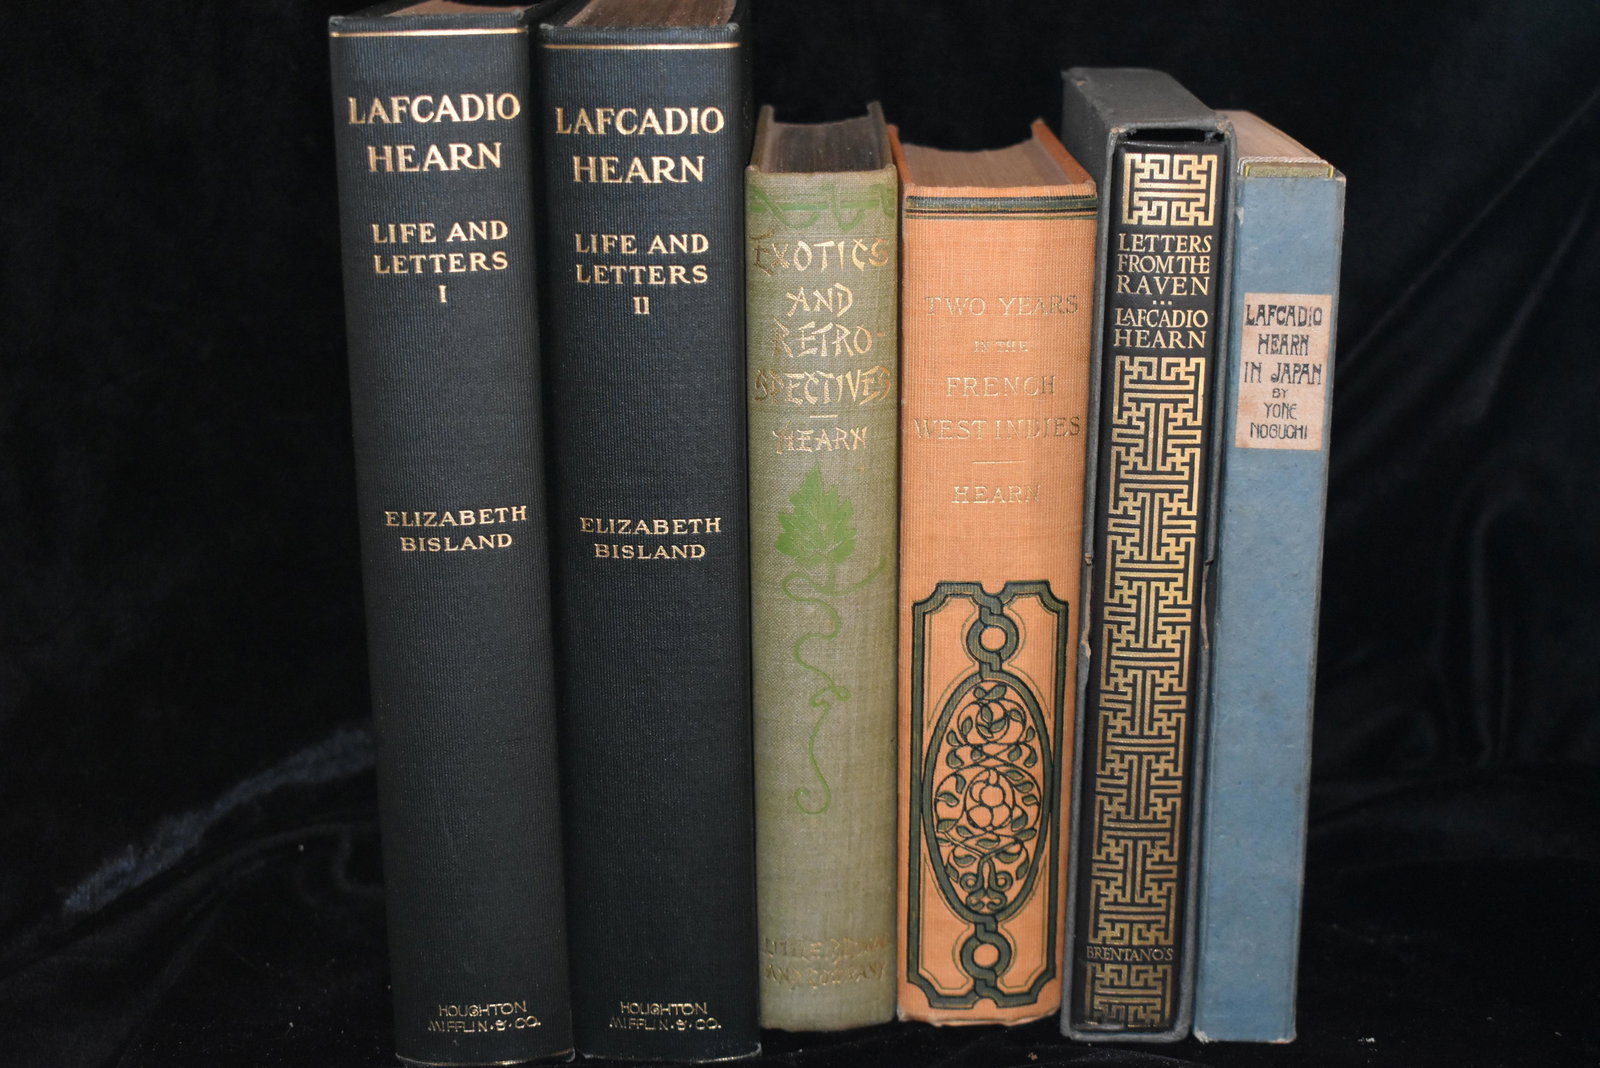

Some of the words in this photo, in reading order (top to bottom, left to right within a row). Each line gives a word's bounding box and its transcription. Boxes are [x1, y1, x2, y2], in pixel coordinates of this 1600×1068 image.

[348, 92, 521, 125] LAFCADIO
[555, 106, 725, 136] LAFCADIO
[367, 142, 503, 173] HEARN
[572, 155, 705, 184] HEARN
[372, 222, 437, 244] LIFE
[446, 220, 509, 242] AND
[574, 233, 637, 255] LIFE
[647, 233, 709, 255] AND
[749, 229, 889, 277] EXOTICS
[1118, 233, 1213, 253] LETTERS
[373, 251, 509, 275] LETTERS
[1117, 254, 1175, 274] FROM
[1176, 255, 1211, 274] THE
[575, 264, 709, 285] LETTERS
[1115, 274, 1211, 296] RAVEN
[438, 285, 448, 303] I
[786, 282, 854, 318] AND
[633, 296, 650, 315] II
[925, 296, 987, 316] TWO
[998, 295, 1079, 316] YEARS
[1244, 304, 1323, 327] LAFCADIO
[1114, 307, 1209, 328] LAFCADIO
[974, 340, 991, 353] IN
[995, 340, 1029, 353] THE
[1113, 328, 1207, 349] HEARN
[1257, 333, 1310, 356] HEARN
[1244, 361, 1262, 384] IN
[1270, 362, 1322, 385] JAPAN
[753, 365, 891, 407] SPECTIVES
[946, 375, 1056, 397] FRENCH
[1272, 387, 1288, 399] BY
[1263, 402, 1298, 420] YONE
[913, 417, 987, 440] WEST
[995, 416, 1081, 440] INDIES
[1250, 422, 1308, 440] NOGUCHI
[772, 424, 868, 455] HEARN
[951, 484, 1041, 504] HEARN
[384, 505, 527, 527] ELIZABETH
[579, 516, 722, 535] ELIZABETH
[399, 533, 513, 552] BISLAND
[594, 543, 706, 560] BISLAND
[1086, 945, 1174, 961] BRENTANO'S
[439, 1000, 528, 1017] HOUGHTON
[620, 1000, 708, 1016] HOUGHTON
